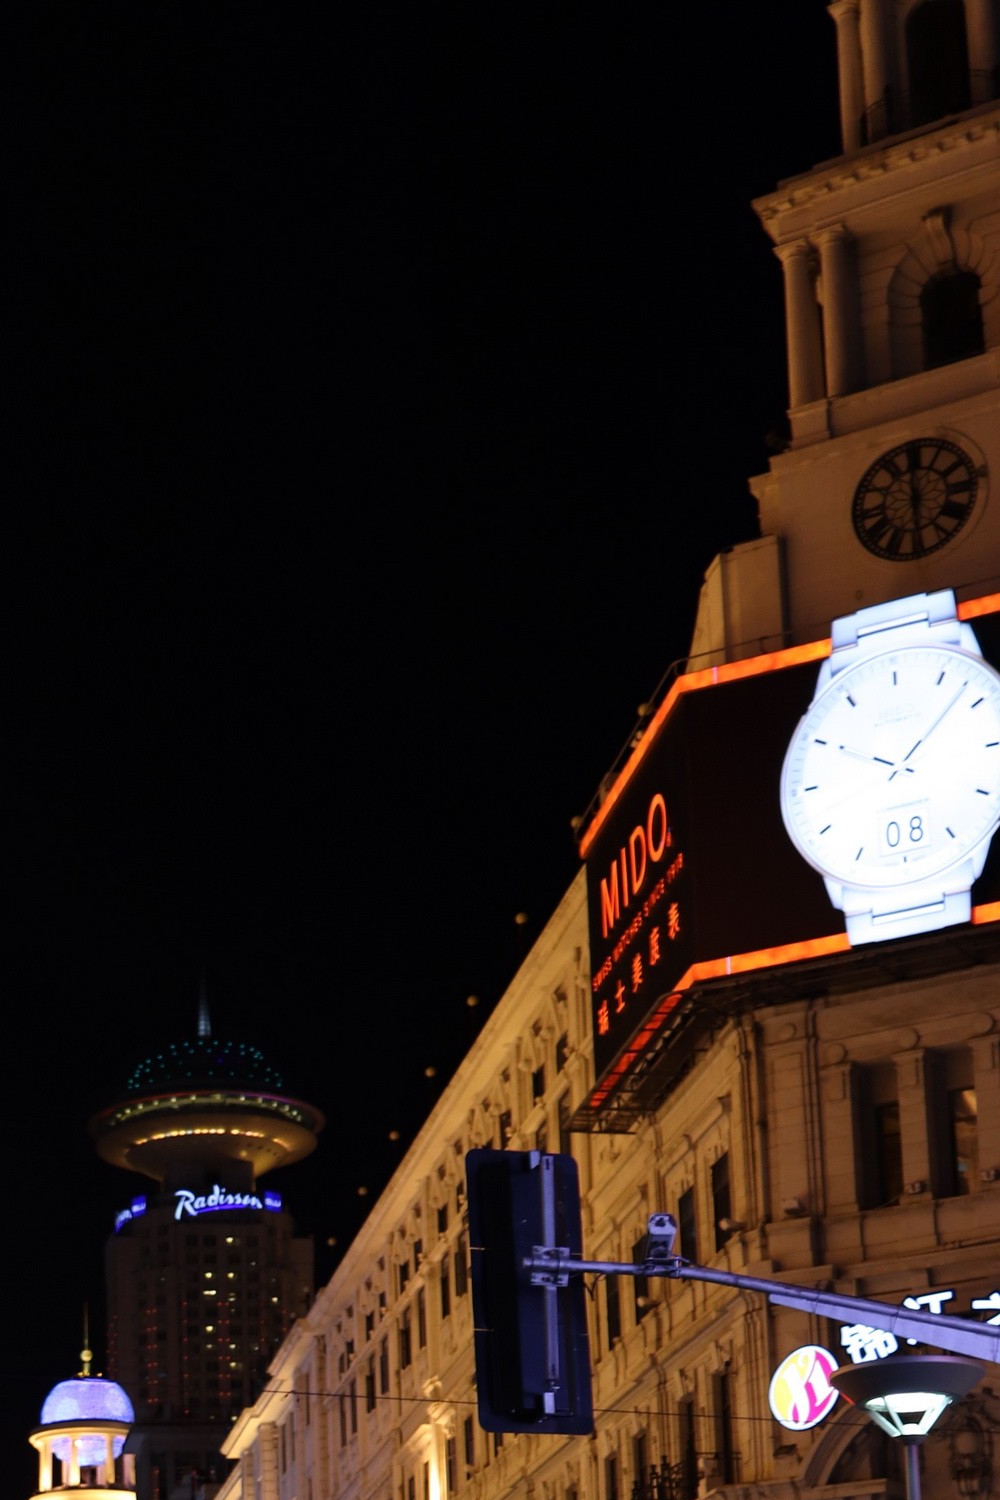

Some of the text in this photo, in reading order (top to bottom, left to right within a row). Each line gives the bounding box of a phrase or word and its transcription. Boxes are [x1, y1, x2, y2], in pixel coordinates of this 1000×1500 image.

[886, 815, 924, 848] 08
[600, 793, 668, 938] MIDO
[174, 1184, 263, 1221] Radisson
